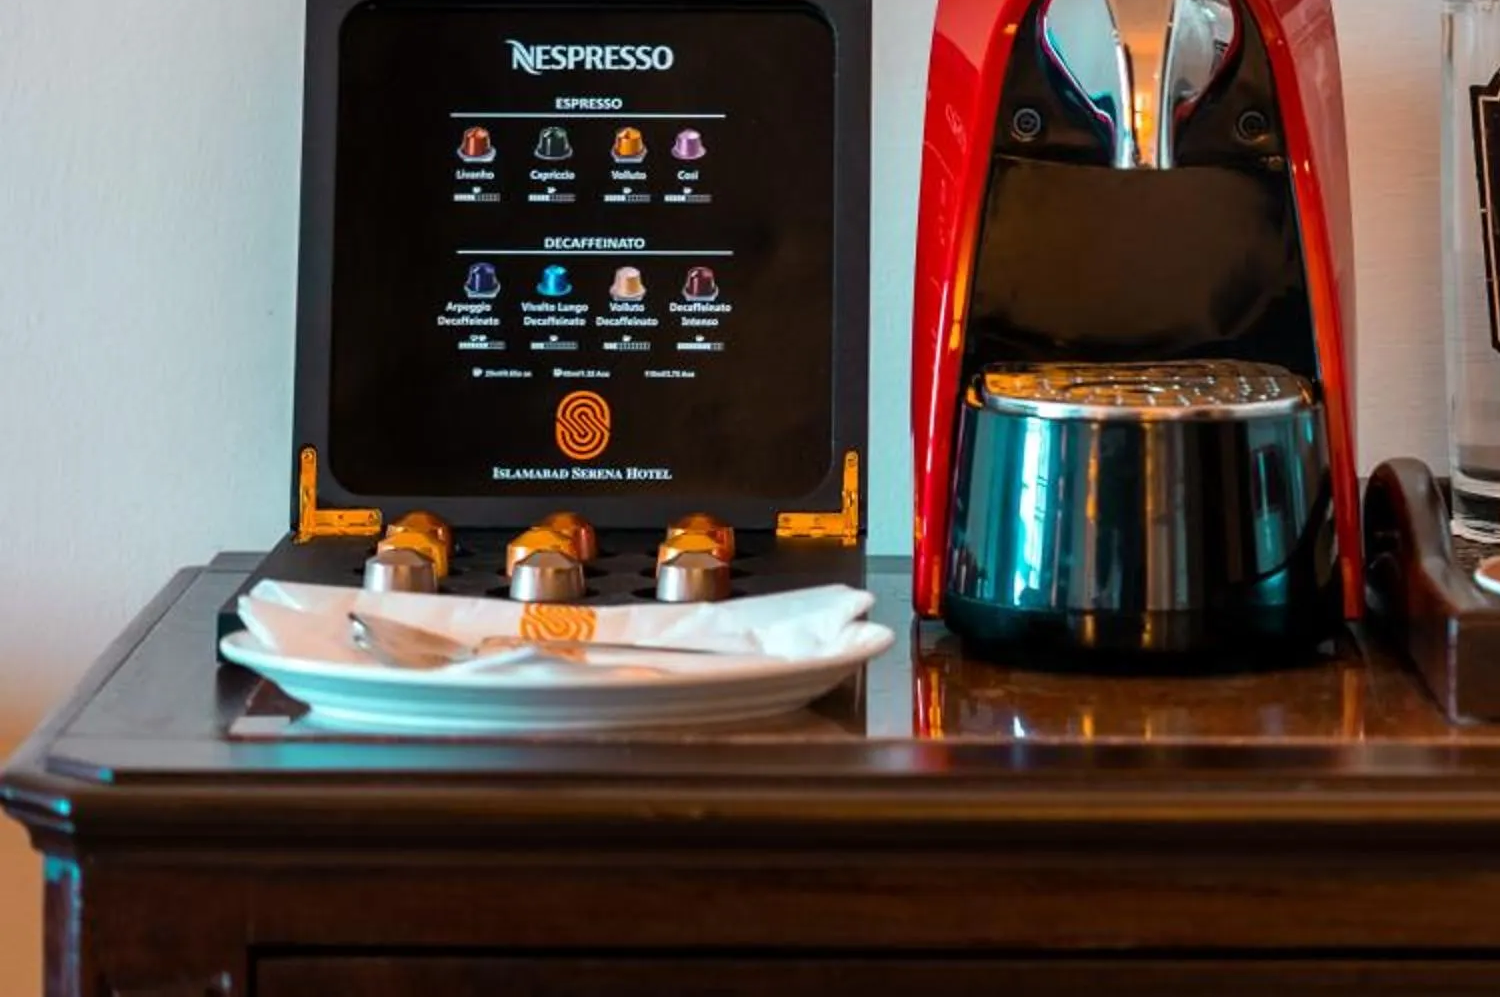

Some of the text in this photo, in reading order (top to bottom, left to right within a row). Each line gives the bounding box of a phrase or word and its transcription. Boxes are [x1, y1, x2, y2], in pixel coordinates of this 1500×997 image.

[505, 40, 674, 75] NESPRESSO
[555, 97, 623, 110] ESPRESSO
[530, 169, 576, 182] Capriccio
[544, 237, 645, 250] DECAFFEINATO
[445, 302, 492, 314] Arpeggio
[557, 302, 589, 314] Lungo
[669, 302, 732, 312] Decaffeinato
[437, 316, 500, 326] Decaffeinato
[523, 316, 587, 326] Decaffeinato
[595, 316, 659, 327] Decaffeinato
[492, 466, 673, 480] ISLAMABAD SERENA HOTEL
